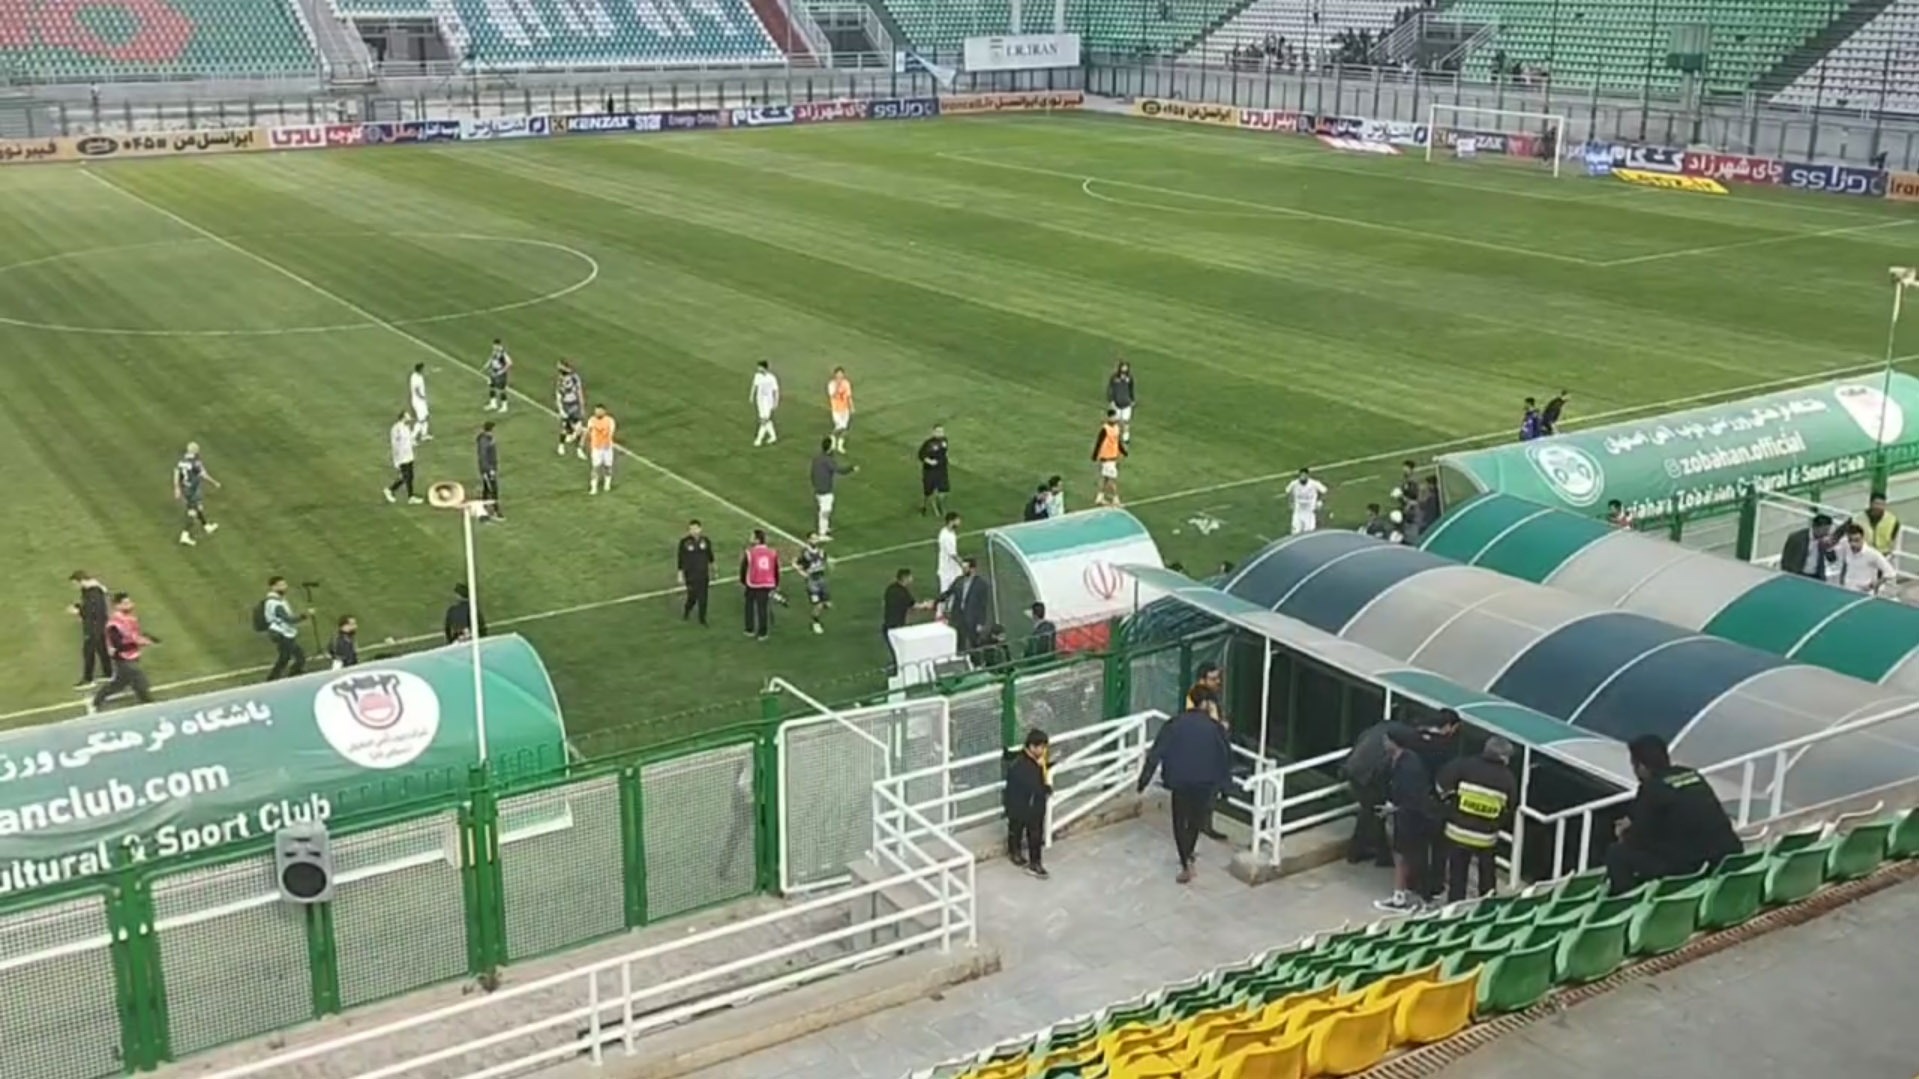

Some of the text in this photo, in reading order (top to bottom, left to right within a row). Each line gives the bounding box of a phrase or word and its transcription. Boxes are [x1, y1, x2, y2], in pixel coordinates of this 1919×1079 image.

[1688, 153, 1749, 179] شهرزاد
[59, 716, 177, 769] فرهنگی
[181, 699, 273, 736] باشگاه
[0, 763, 230, 835] anclub.com
[156, 813, 250, 857] Sport
[259, 792, 332, 833] Club
